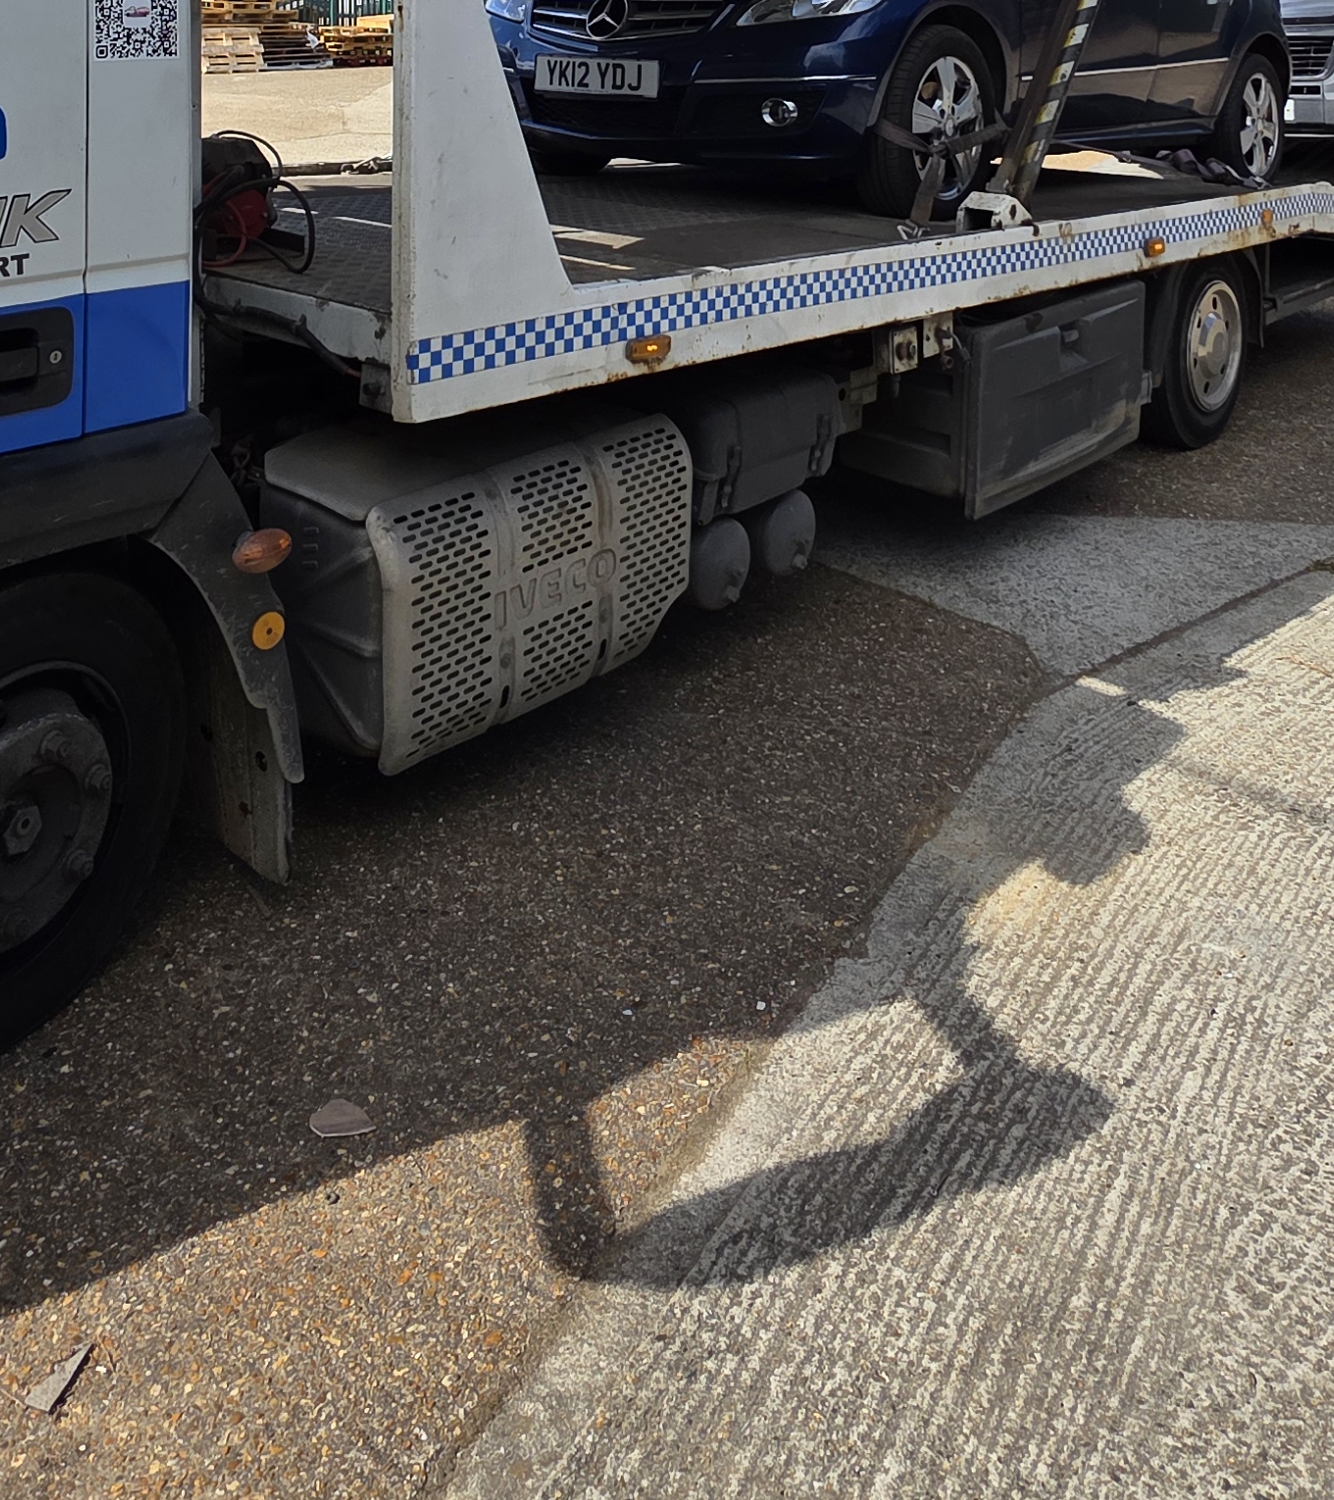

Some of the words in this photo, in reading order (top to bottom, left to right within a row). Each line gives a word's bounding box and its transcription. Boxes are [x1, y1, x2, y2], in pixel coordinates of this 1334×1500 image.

[547, 59, 590, 88] YK12
[597, 62, 643, 91] YDJ
[493, 548, 617, 632] IVECO
